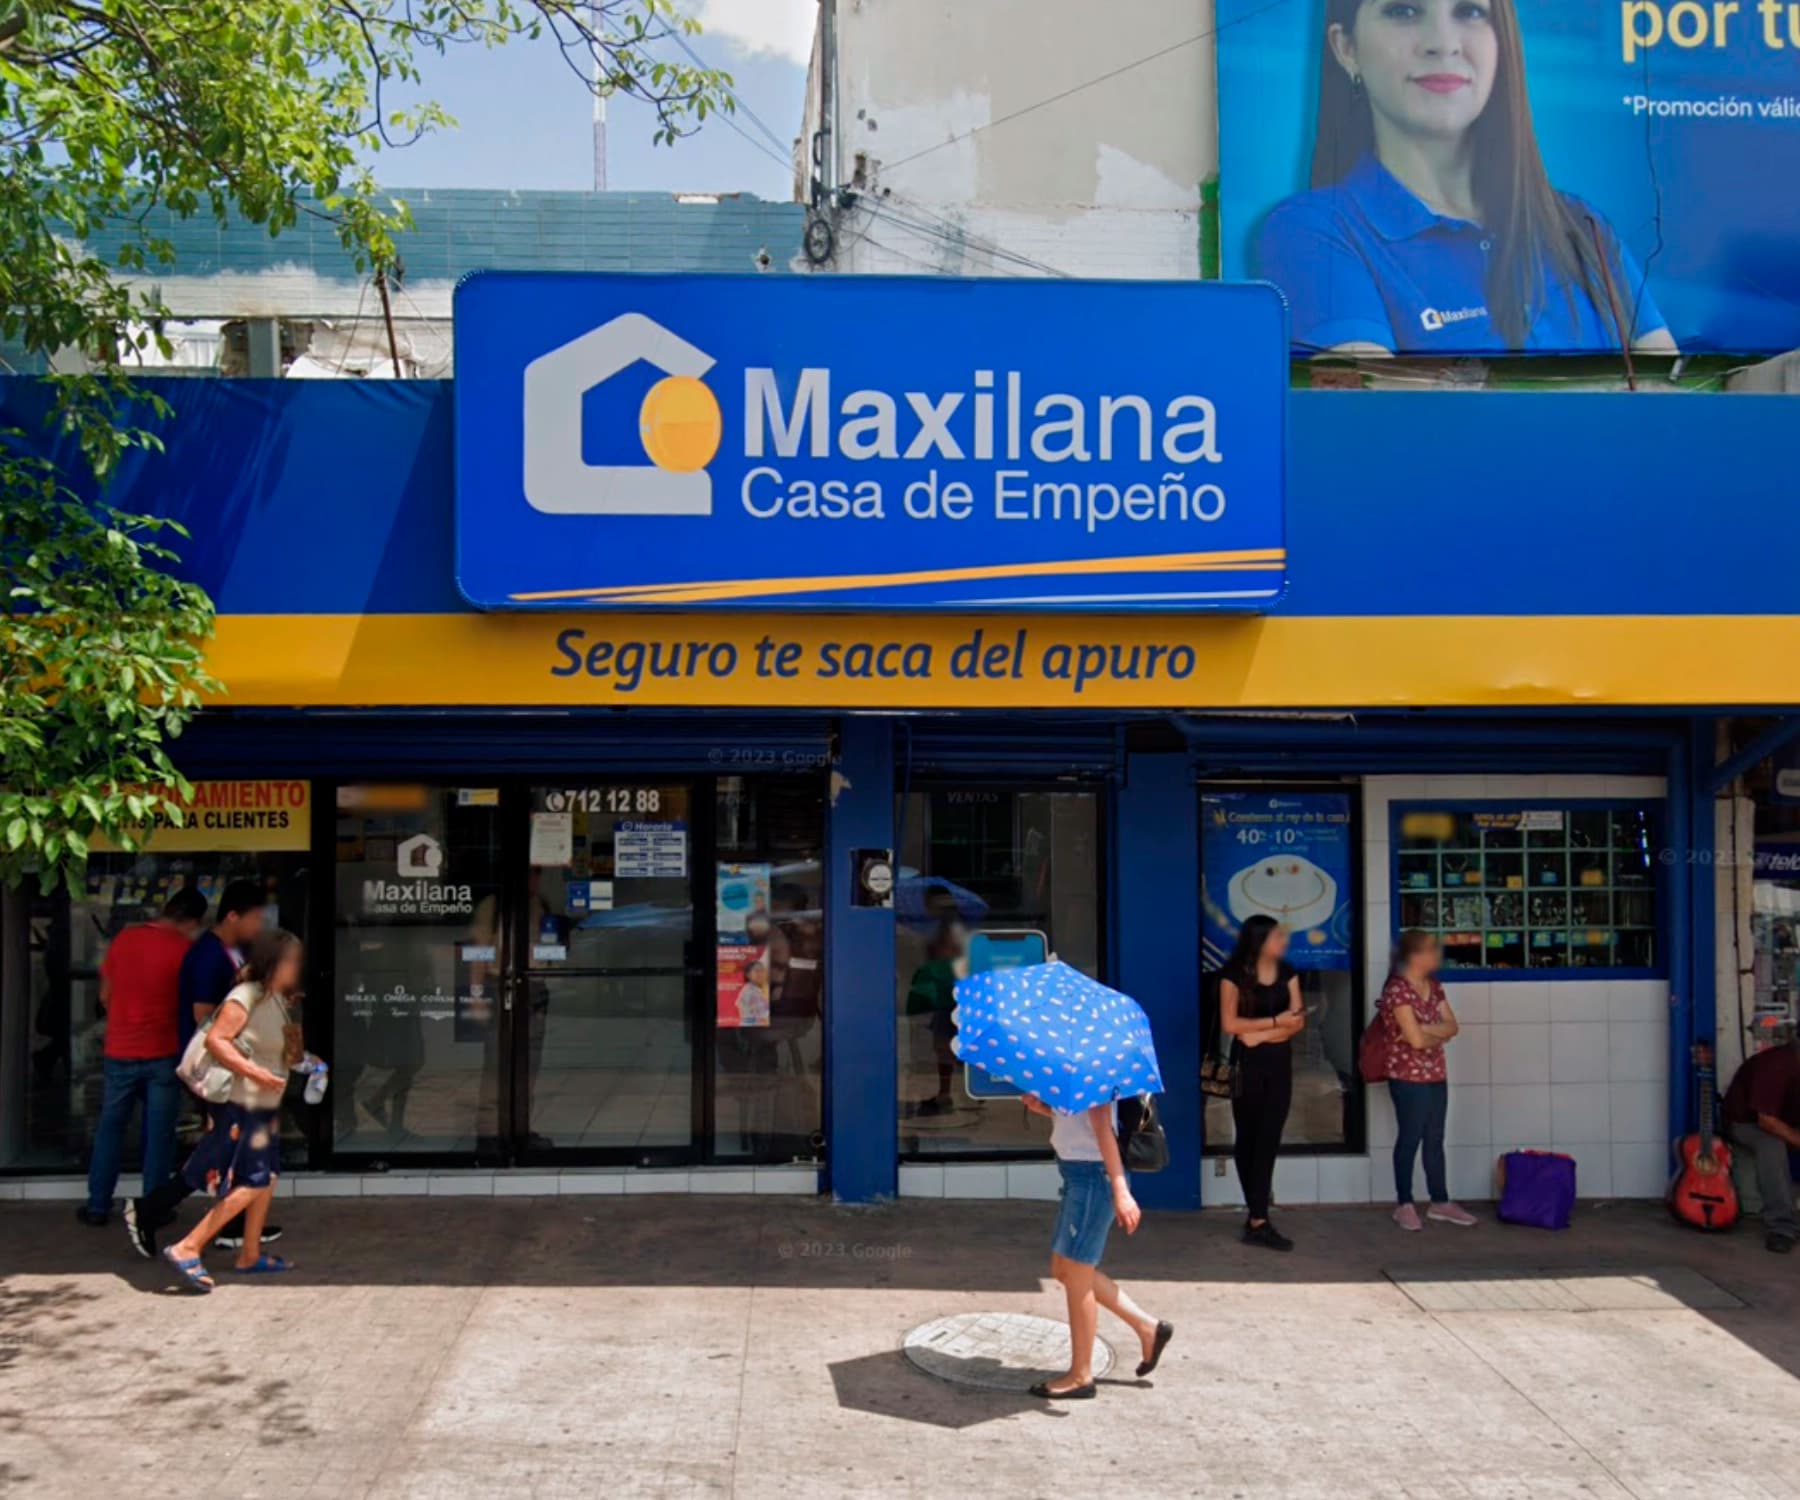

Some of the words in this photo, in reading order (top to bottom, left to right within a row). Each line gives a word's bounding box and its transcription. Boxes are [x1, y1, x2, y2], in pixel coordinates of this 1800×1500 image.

[1621, 1, 1739, 63] por
[744, 367, 1223, 466] Maxilana
[740, 467, 887, 521] Casa
[903, 469, 975, 520] de
[994, 470, 1227, 532] Empeño
[551, 629, 738, 691] Seguro
[755, 634, 800, 679] te
[816, 640, 932, 680] saca
[951, 629, 1024, 680] del
[1040, 644, 1196, 693] apuro
[155, 811, 199, 829] PAA
[205, 811, 290, 830] CLIENTES
[565, 789, 601, 813] 712
[606, 789, 631, 813] 12
[636, 789, 660, 813] 88
[362, 879, 473, 902] Maxilana
[364, 902, 397, 914] asa
[400, 901, 417, 914] de
[420, 901, 473, 916] Empeño
